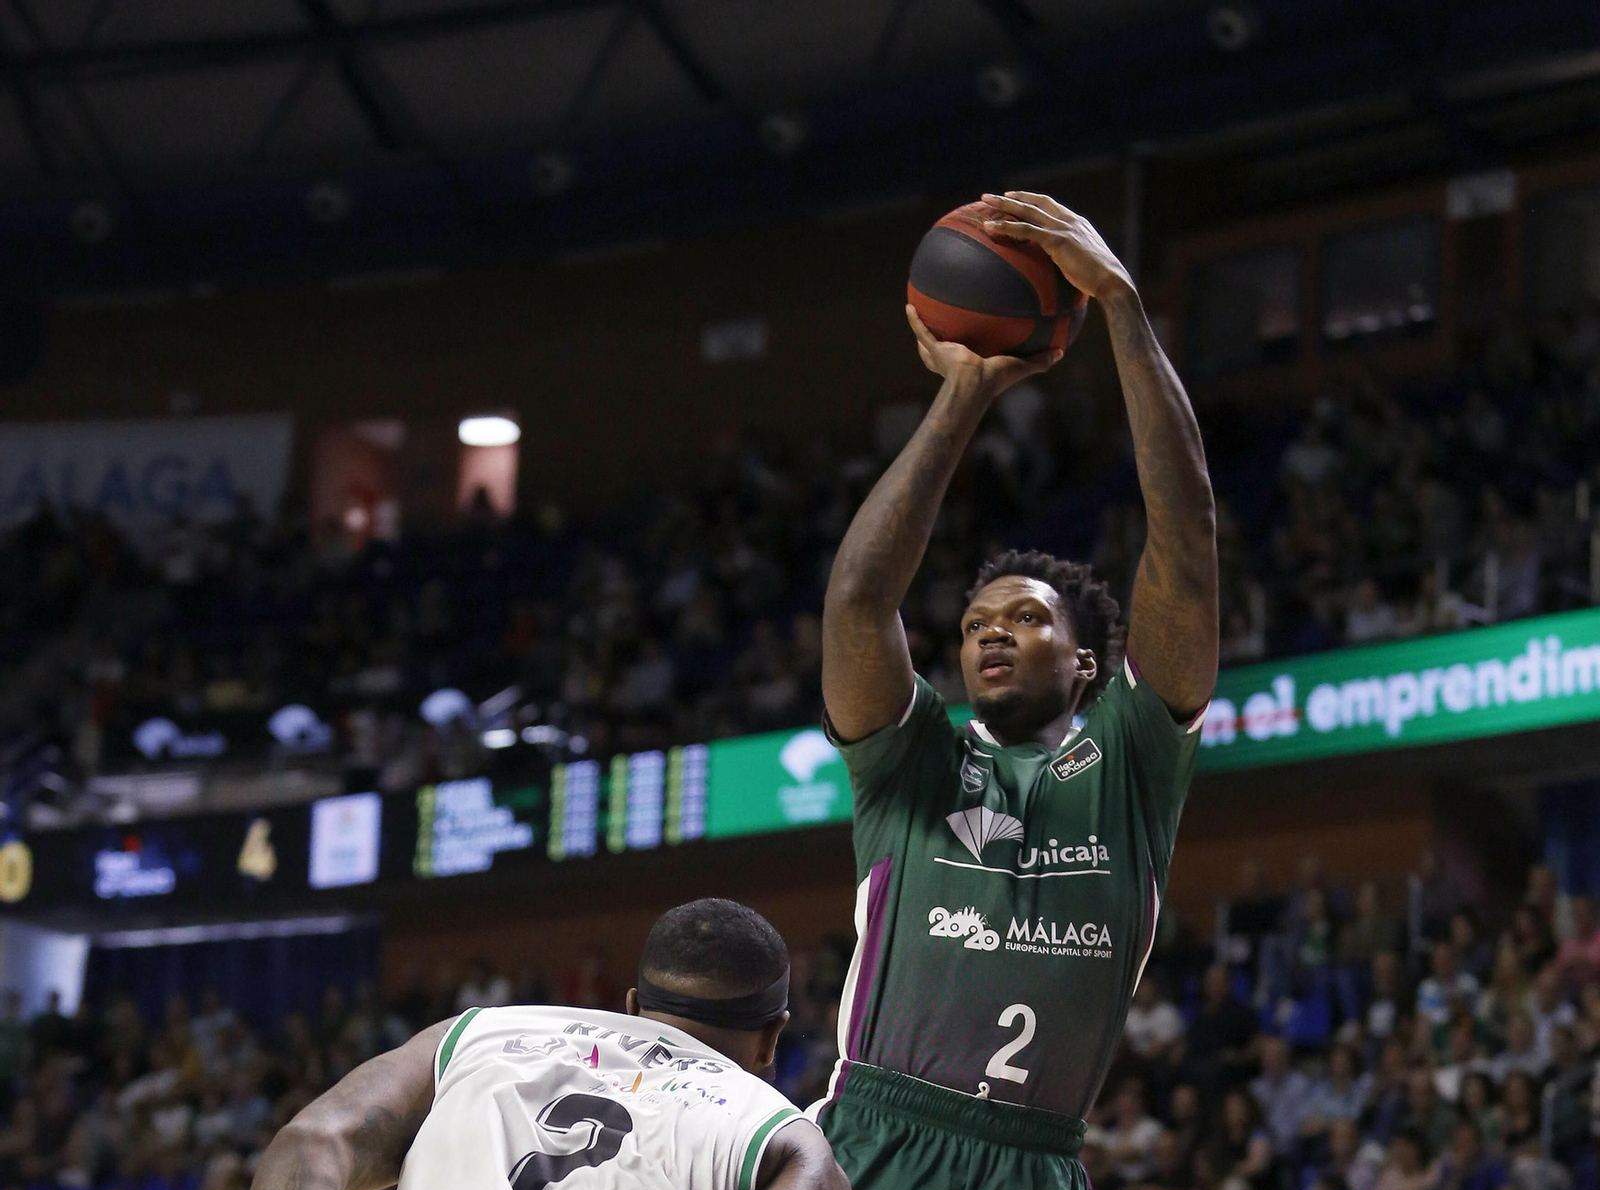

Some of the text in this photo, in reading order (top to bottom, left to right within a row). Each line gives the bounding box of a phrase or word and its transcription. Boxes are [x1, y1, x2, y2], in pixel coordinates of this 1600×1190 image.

[1242, 673, 1300, 741] el
[1057, 758, 1076, 774] liga
[1061, 752, 1097, 777] endesa
[1017, 835, 1110, 869] Unicaja
[1006, 916, 1112, 947] MÁLAGA
[1005, 943, 1112, 958] EUROPEAN CAPITAL OF SPORT
[563, 1022, 733, 1073] RIVERS
[985, 1003, 1037, 1085] 2
